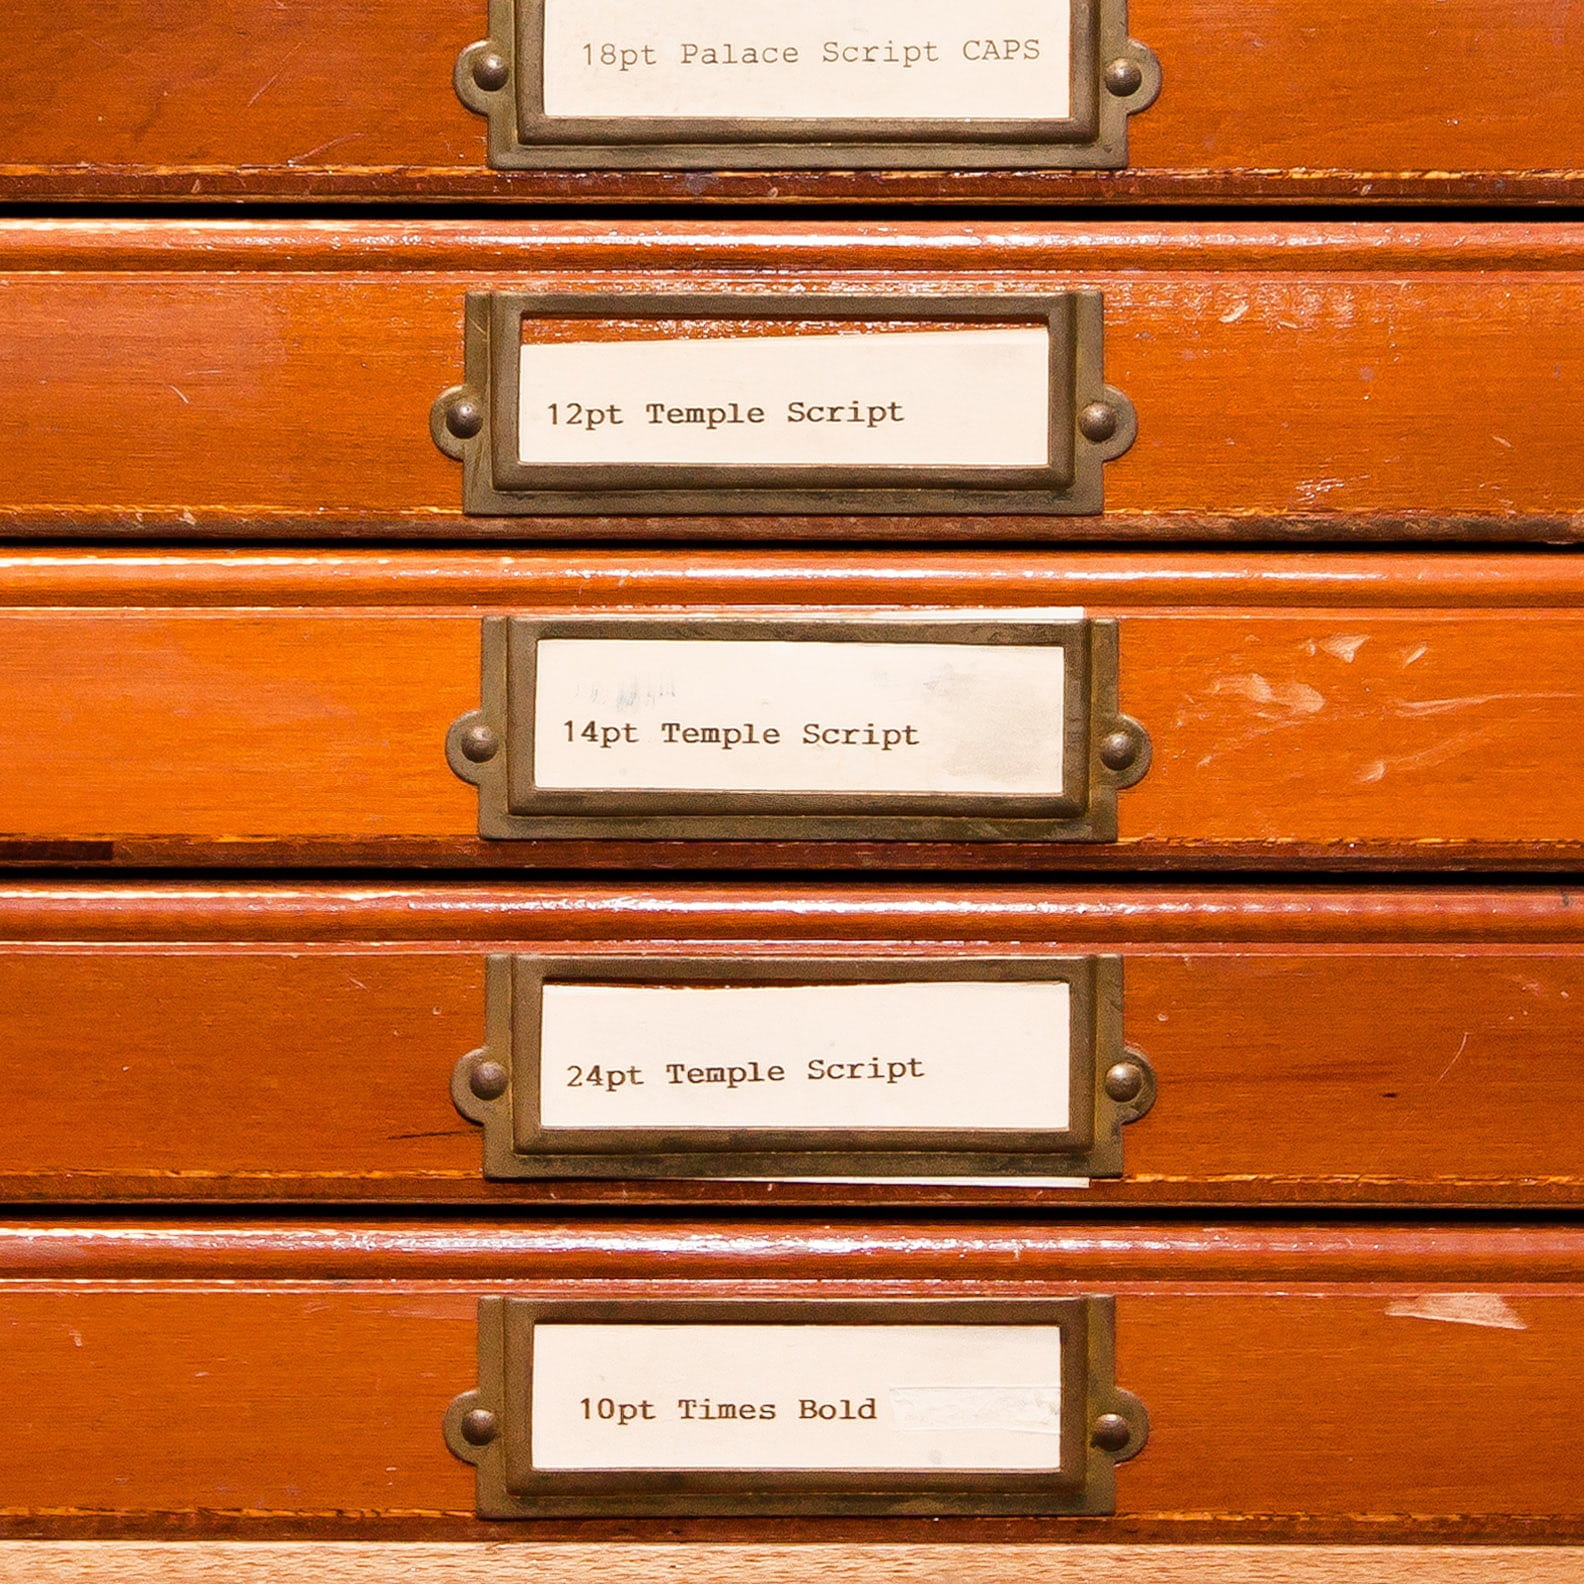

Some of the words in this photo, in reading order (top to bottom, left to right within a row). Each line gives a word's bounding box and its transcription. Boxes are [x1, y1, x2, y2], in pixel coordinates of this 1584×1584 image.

[583, 42, 657, 72] 18pt
[680, 43, 799, 65] Palace
[822, 41, 939, 69] Script
[962, 38, 1041, 61] CAPS
[547, 402, 625, 432] 12pt
[645, 402, 765, 431] Temple
[786, 400, 905, 429] Script
[563, 719, 640, 749] 14pt
[660, 722, 781, 751] Temple
[802, 722, 921, 752] Script
[566, 1064, 645, 1093] 24pt
[665, 1061, 786, 1089] Temple
[807, 1056, 926, 1085] Script
[580, 1397, 657, 1426] 10pt
[677, 1397, 777, 1421] Times
[797, 1397, 878, 1421] Bold
